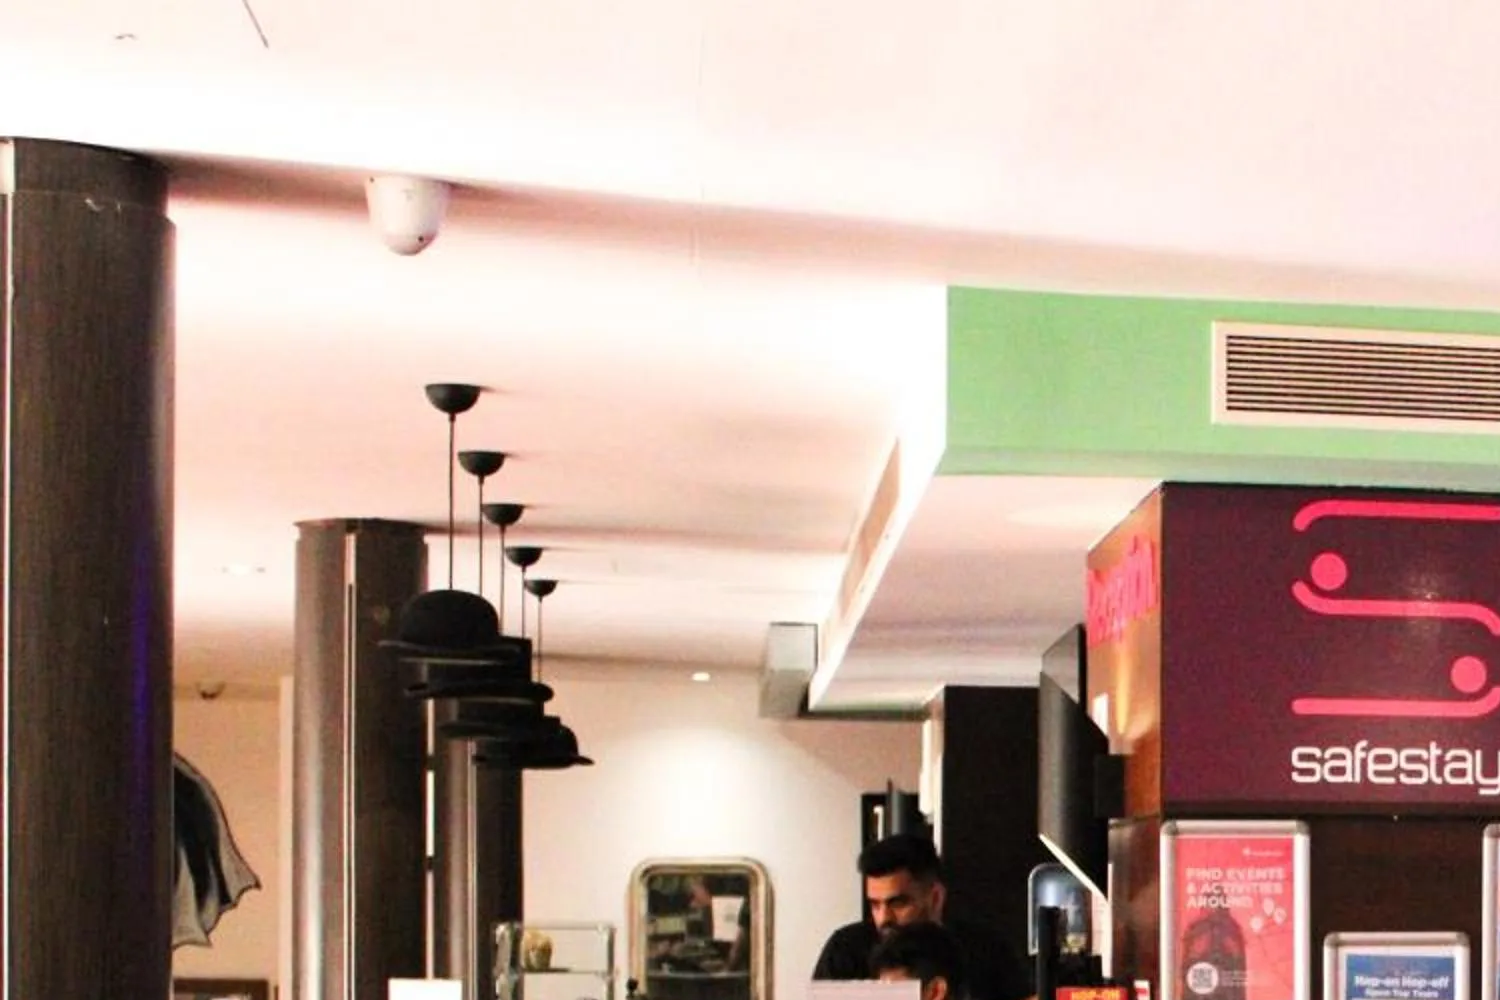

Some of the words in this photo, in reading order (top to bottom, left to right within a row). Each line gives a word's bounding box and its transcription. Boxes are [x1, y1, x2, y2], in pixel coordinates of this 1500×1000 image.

[1185, 867, 1223, 881] FIND
[1226, 867, 1285, 881] EVENTS
[1199, 881, 1283, 895] ACTIVITIES
[1185, 896, 1253, 909] AROUND
[1354, 976, 1400, 988] Hop-on
[1402, 976, 1449, 989] Hop-off
